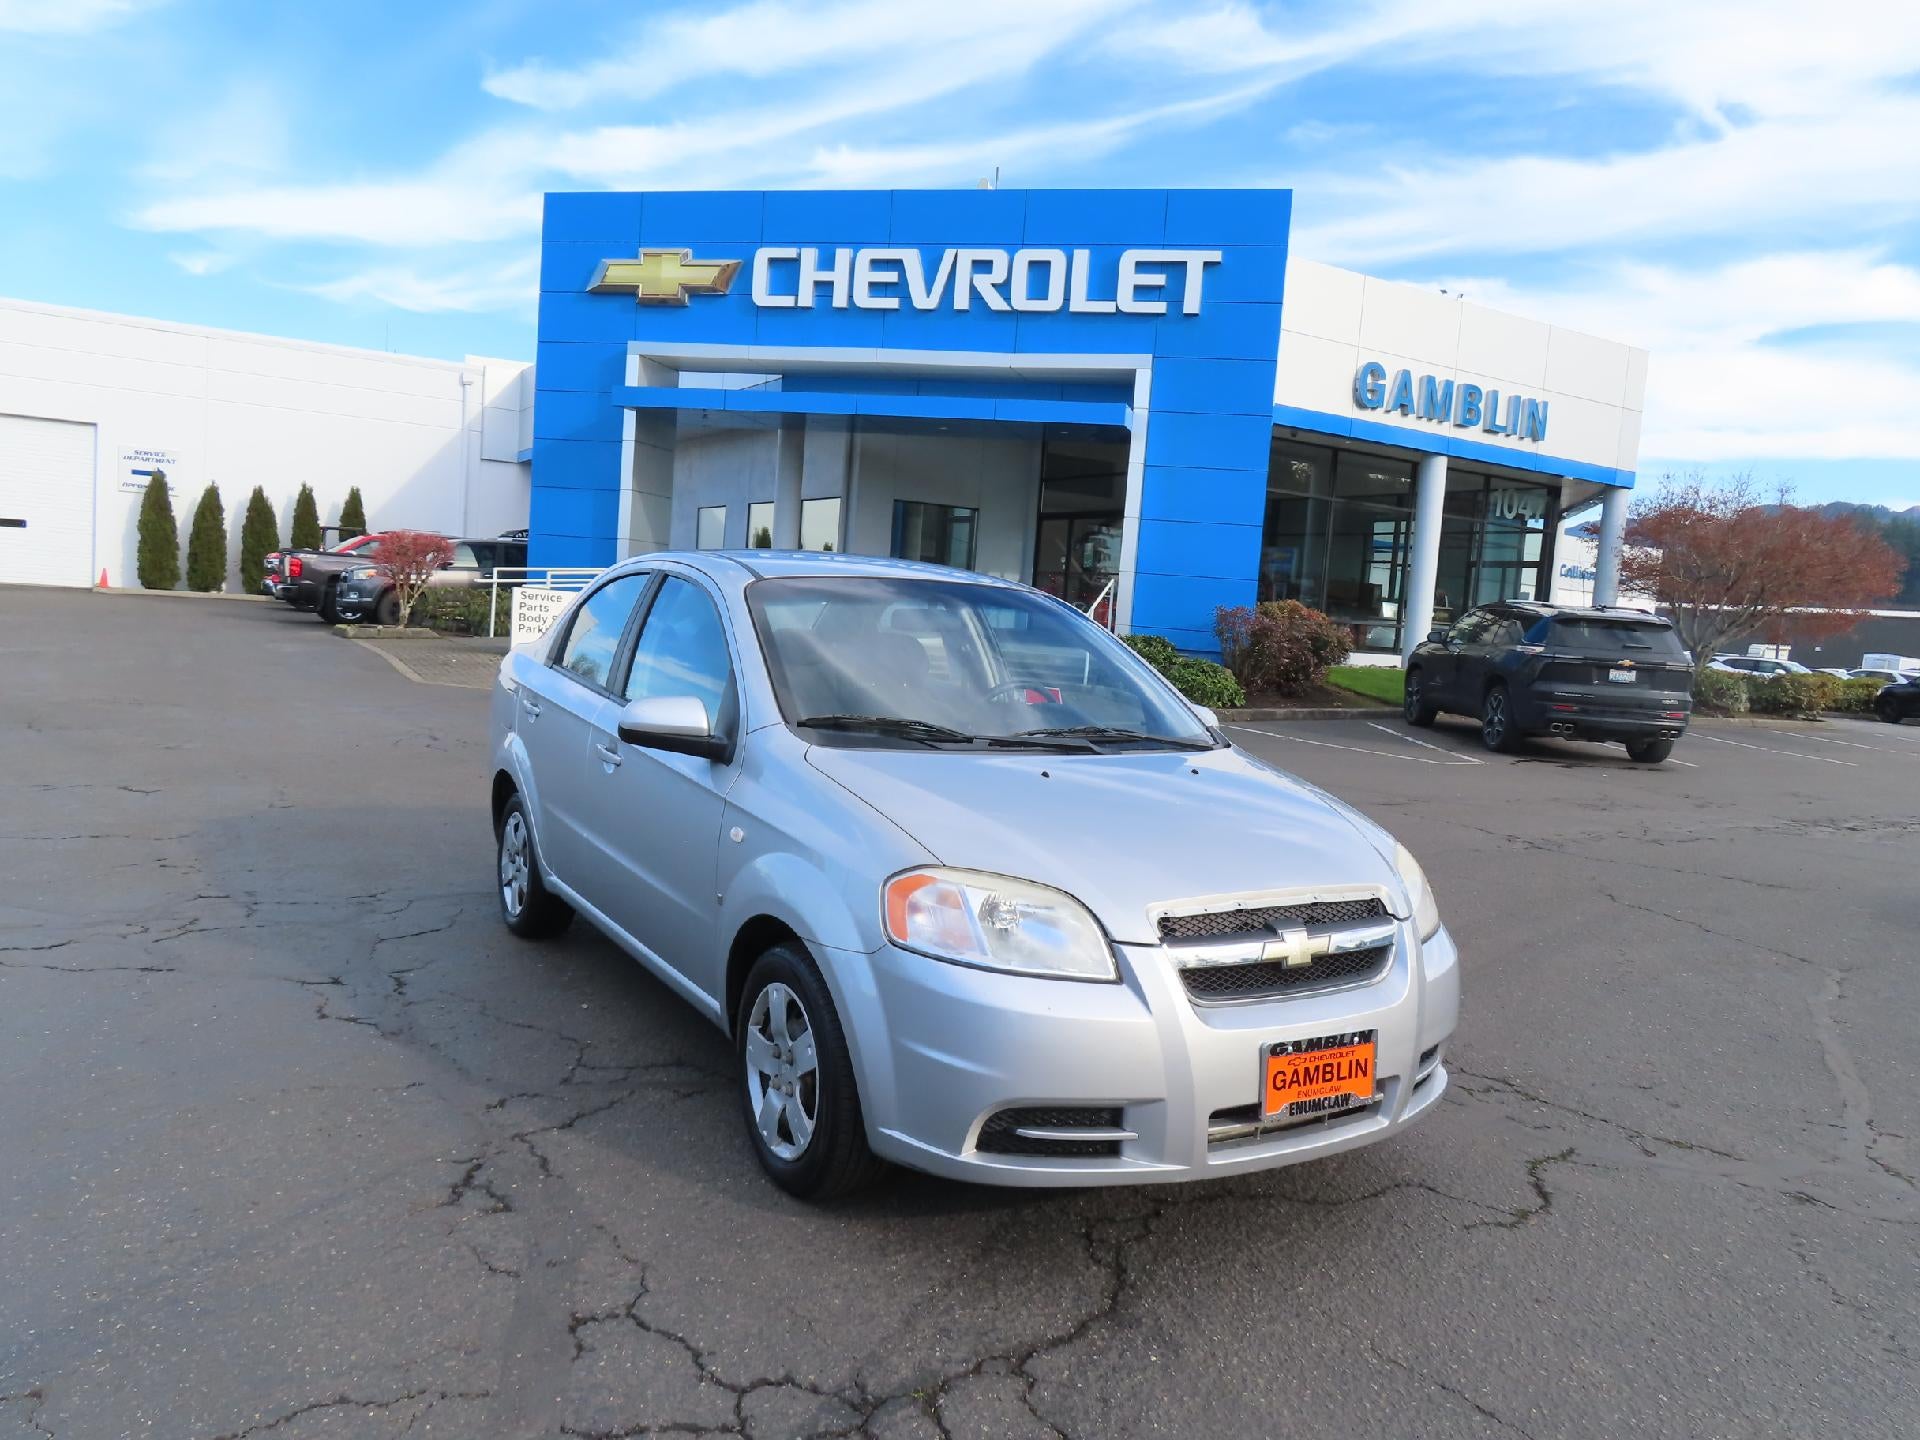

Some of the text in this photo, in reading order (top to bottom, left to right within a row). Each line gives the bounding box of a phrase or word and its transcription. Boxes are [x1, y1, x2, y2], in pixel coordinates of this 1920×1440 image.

[752, 247, 1223, 316] CHEVROLET
[1354, 361, 1549, 441] GAMBLIN
[123, 455, 176, 464] DEPARTMENT
[520, 591, 562, 602] Service
[519, 602, 549, 612] Parts
[518, 613, 547, 625] Body
[1269, 1029, 1374, 1057] GAMBLIN
[1308, 1049, 1356, 1063] CHEVROLET
[1272, 1057, 1368, 1092] GAMBLIN
[1297, 1084, 1342, 1099] ENUMCLAW
[1288, 1092, 1352, 1116] ENUMCLAW
